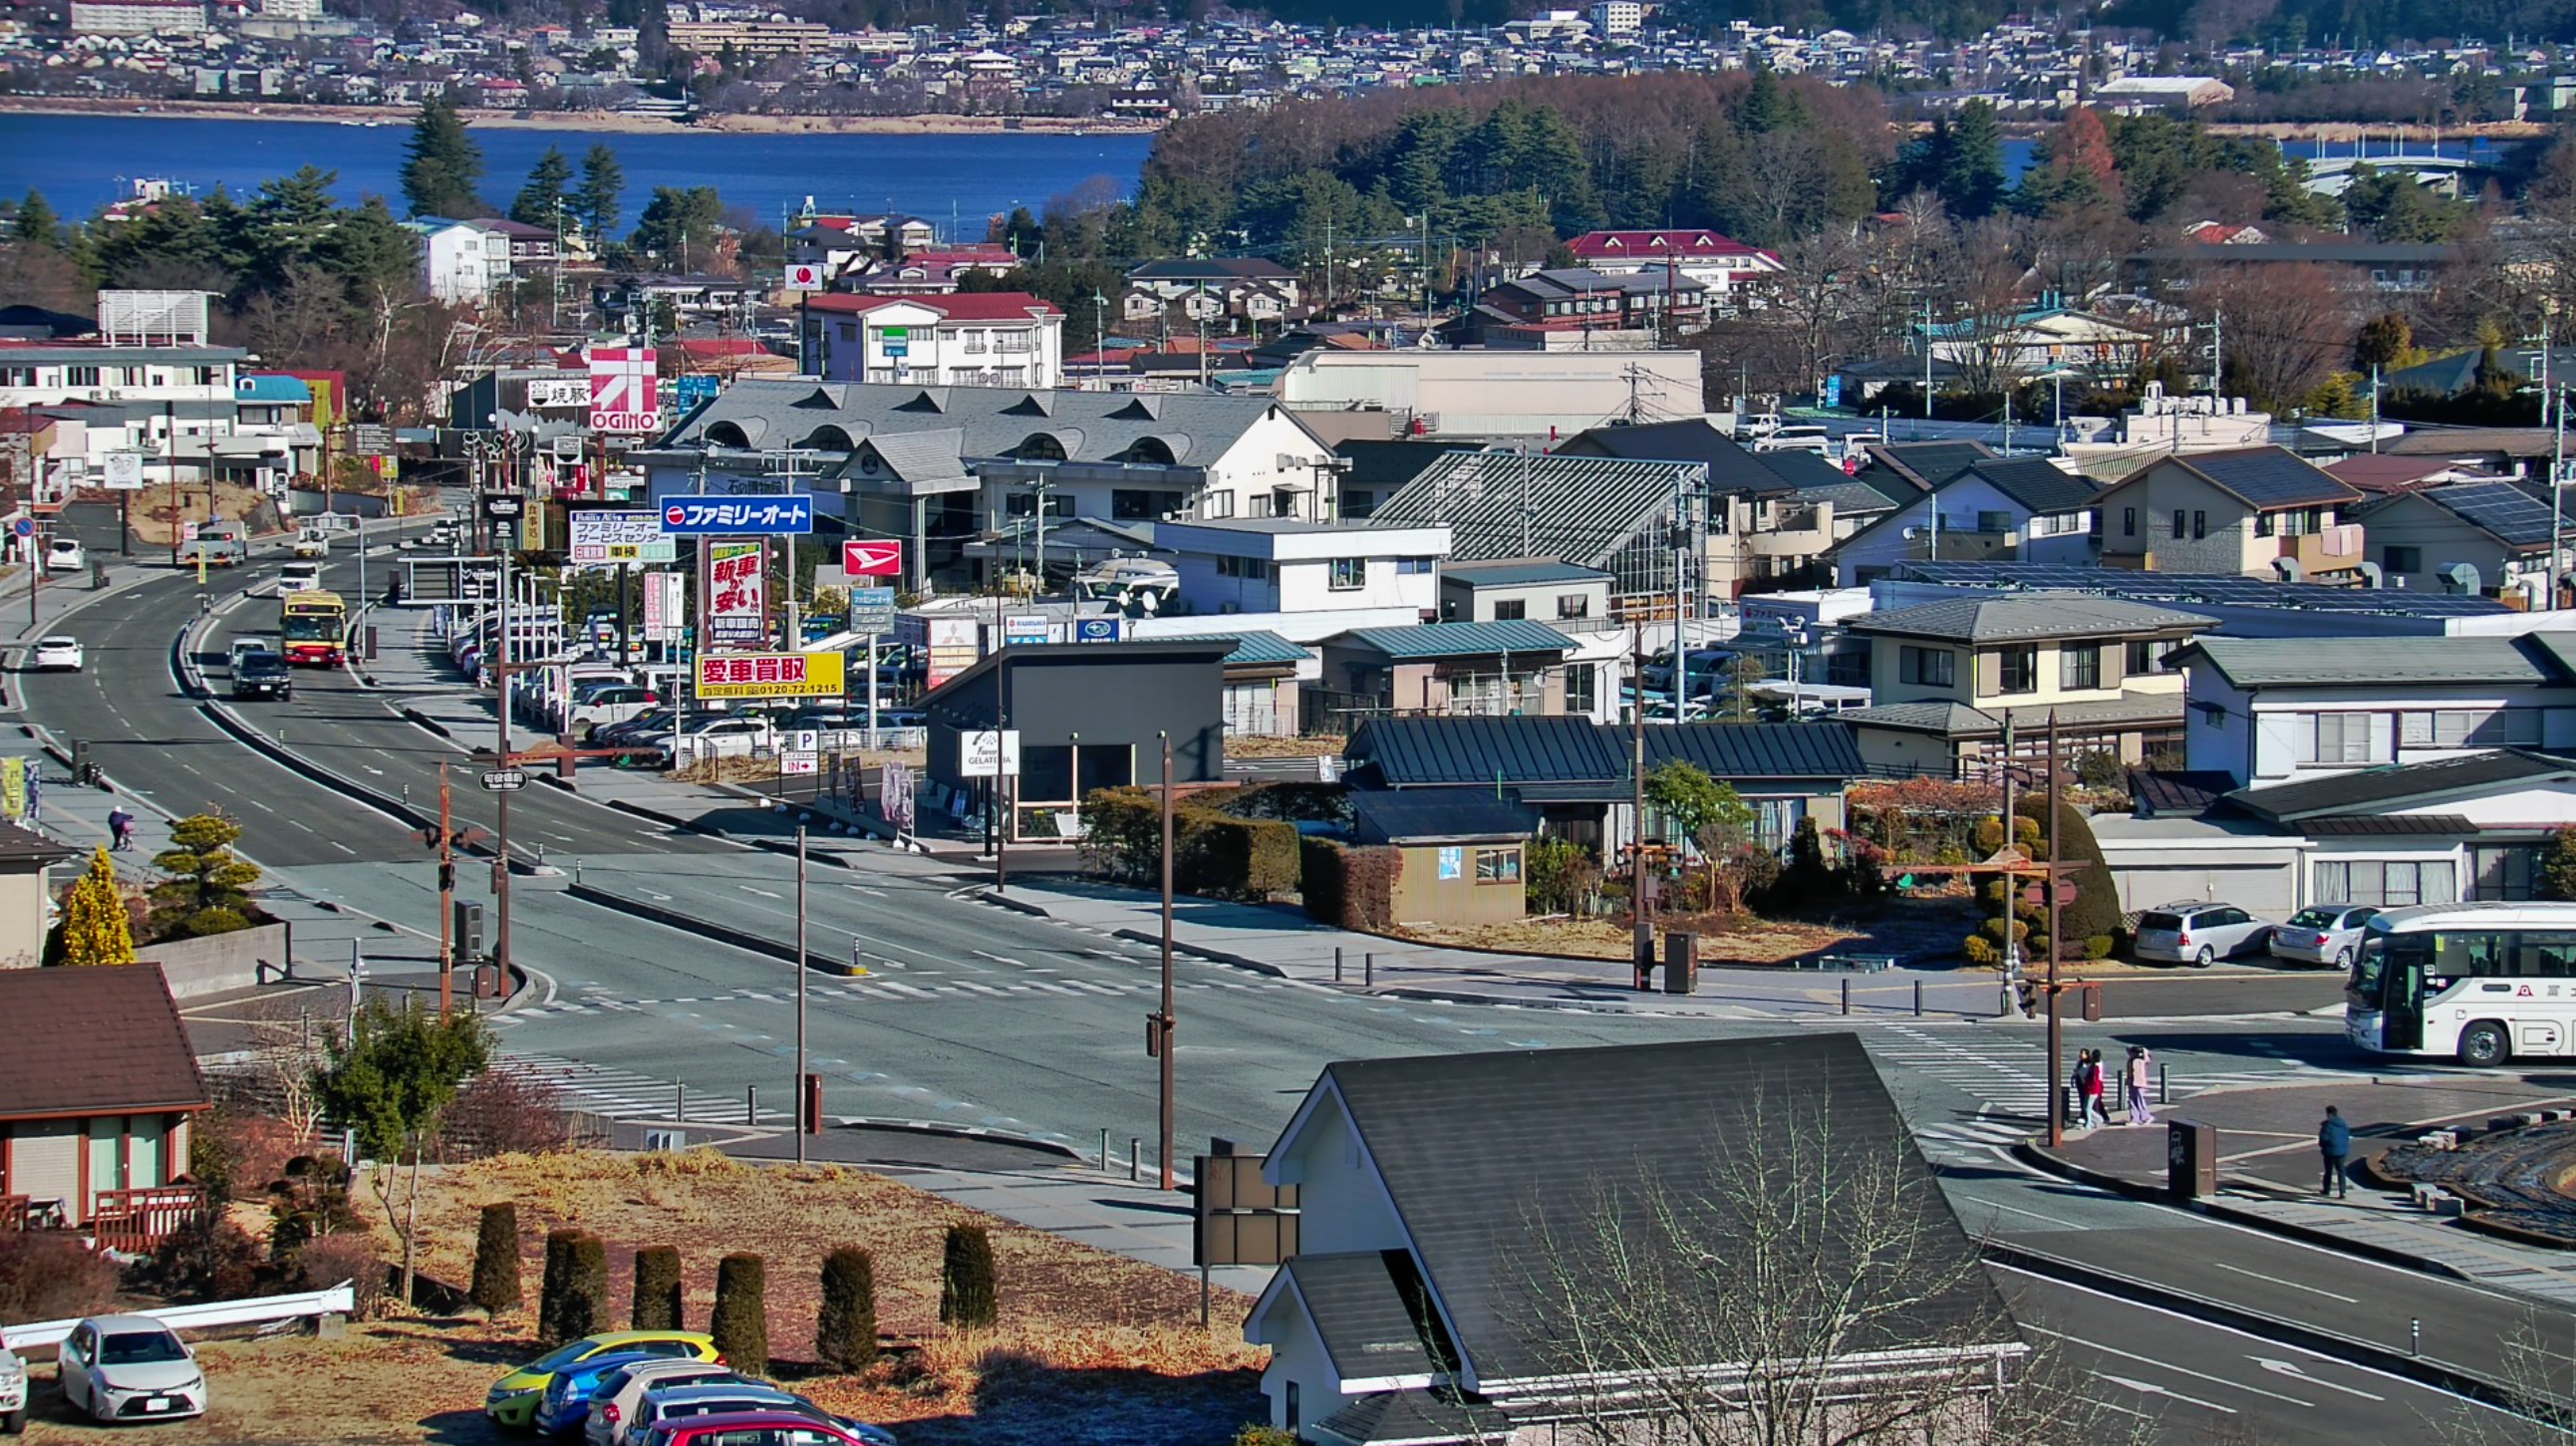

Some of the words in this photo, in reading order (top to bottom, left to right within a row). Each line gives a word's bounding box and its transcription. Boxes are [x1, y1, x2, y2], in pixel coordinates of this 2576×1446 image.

[593, 414, 655, 430] OGINO
[685, 504, 807, 525] ファミリーオート
[576, 534, 671, 543] サービスセンター
[703, 658, 805, 683] 愛車買取
[760, 684, 838, 695] 0120-72-1215
[802, 733, 812, 748] P
[787, 761, 799, 771] IN
